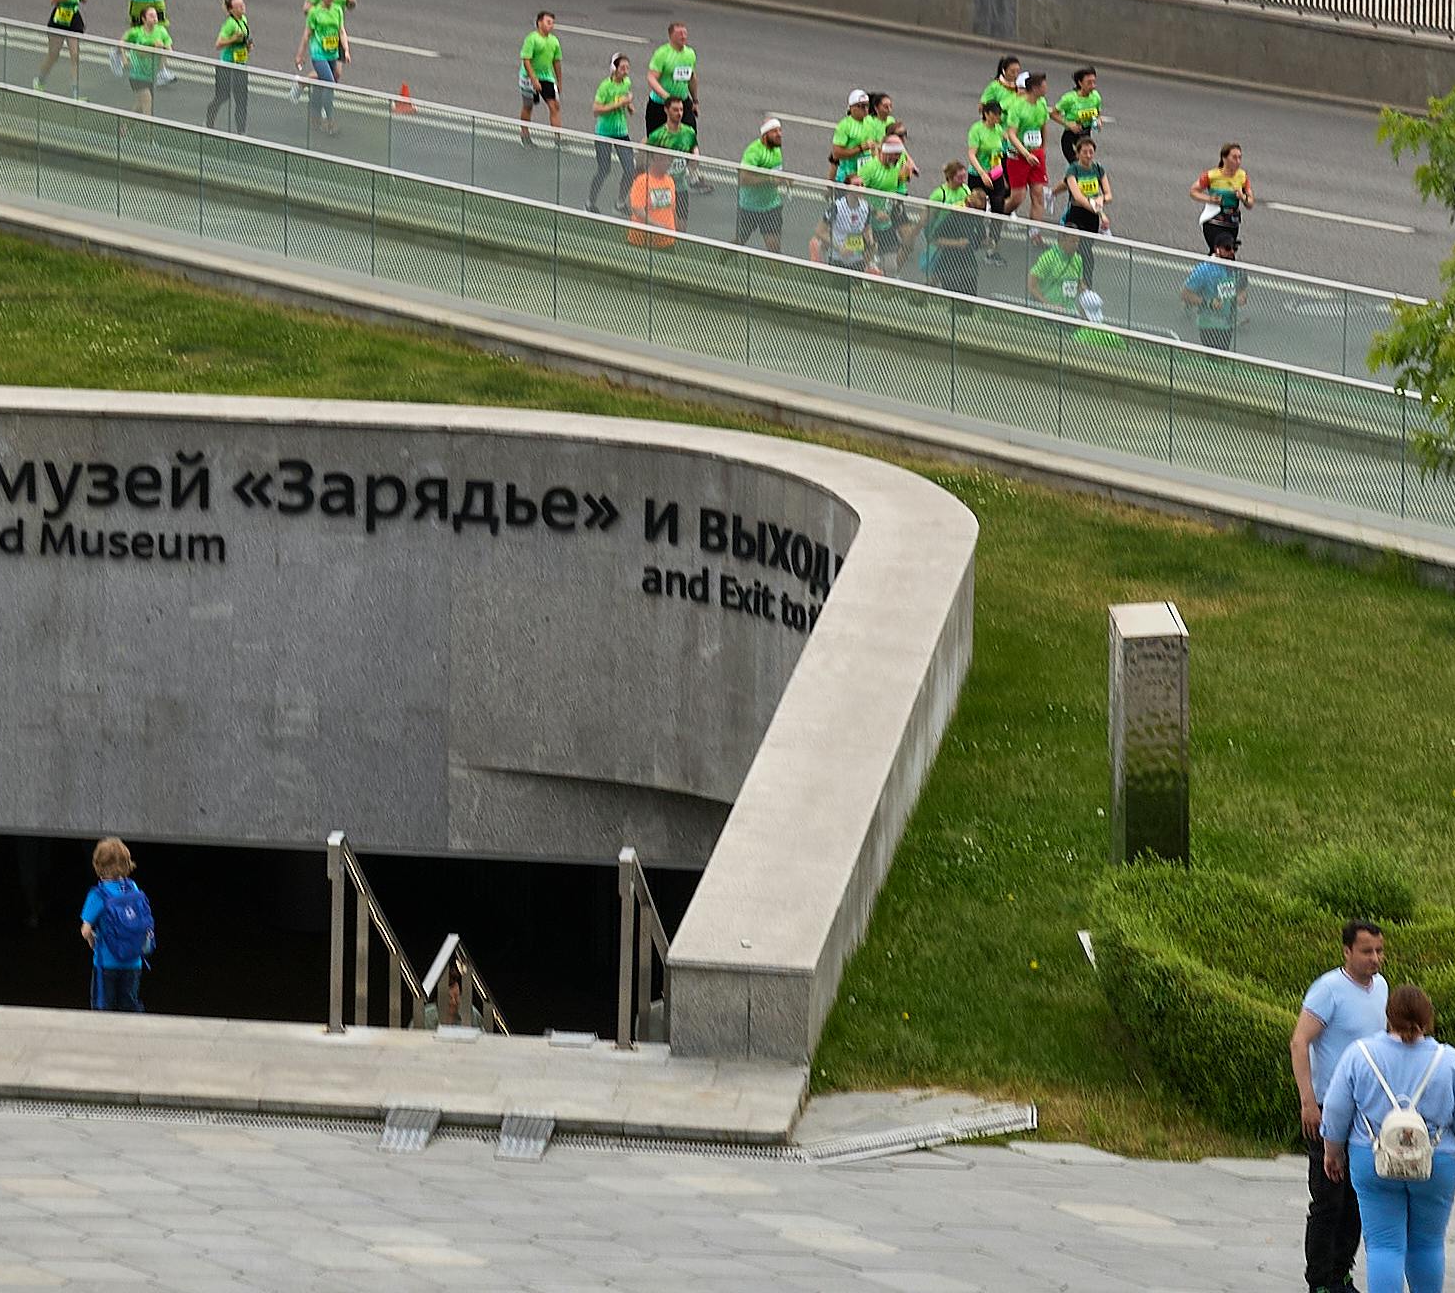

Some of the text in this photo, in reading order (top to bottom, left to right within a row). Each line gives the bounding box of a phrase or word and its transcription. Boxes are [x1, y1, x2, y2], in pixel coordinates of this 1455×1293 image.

[233, 459, 620, 535] «Зарядье»
[644, 497, 679, 546] и
[39, 522, 226, 564] Museum
[641, 566, 710, 603] and
[720, 574, 776, 623] Exit
